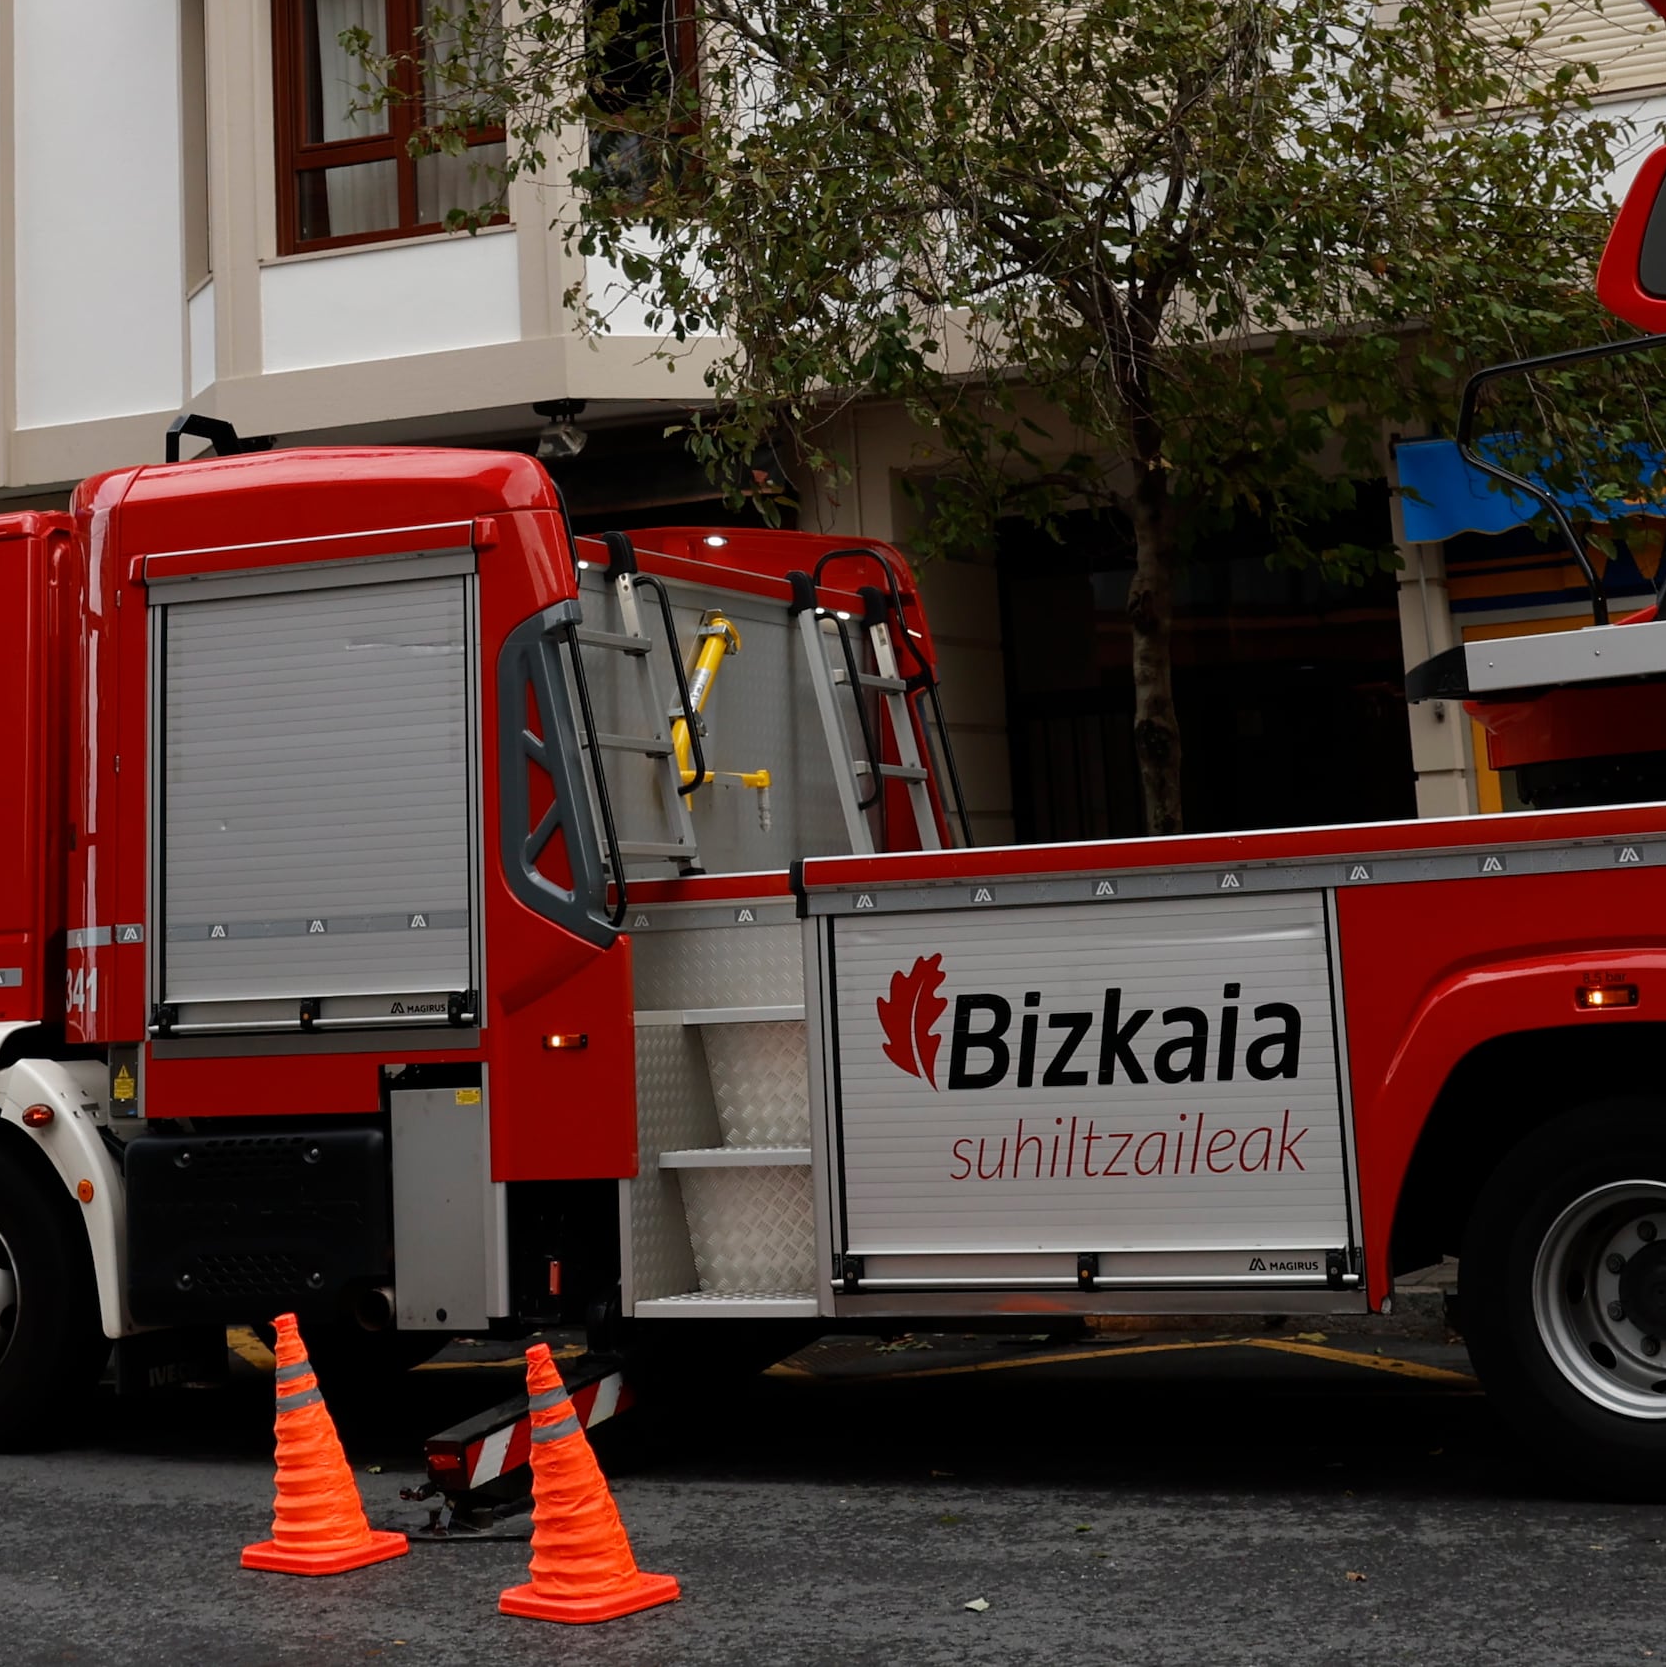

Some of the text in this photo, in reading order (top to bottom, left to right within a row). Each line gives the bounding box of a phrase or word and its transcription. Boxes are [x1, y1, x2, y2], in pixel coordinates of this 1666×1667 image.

[407, 1003, 446, 1014] MAGIRUS
[947, 982, 1302, 1090] Bizkaia
[950, 1109, 1309, 1181] suhiltzaileak
[1269, 1259, 1320, 1272] MAGIRUS
